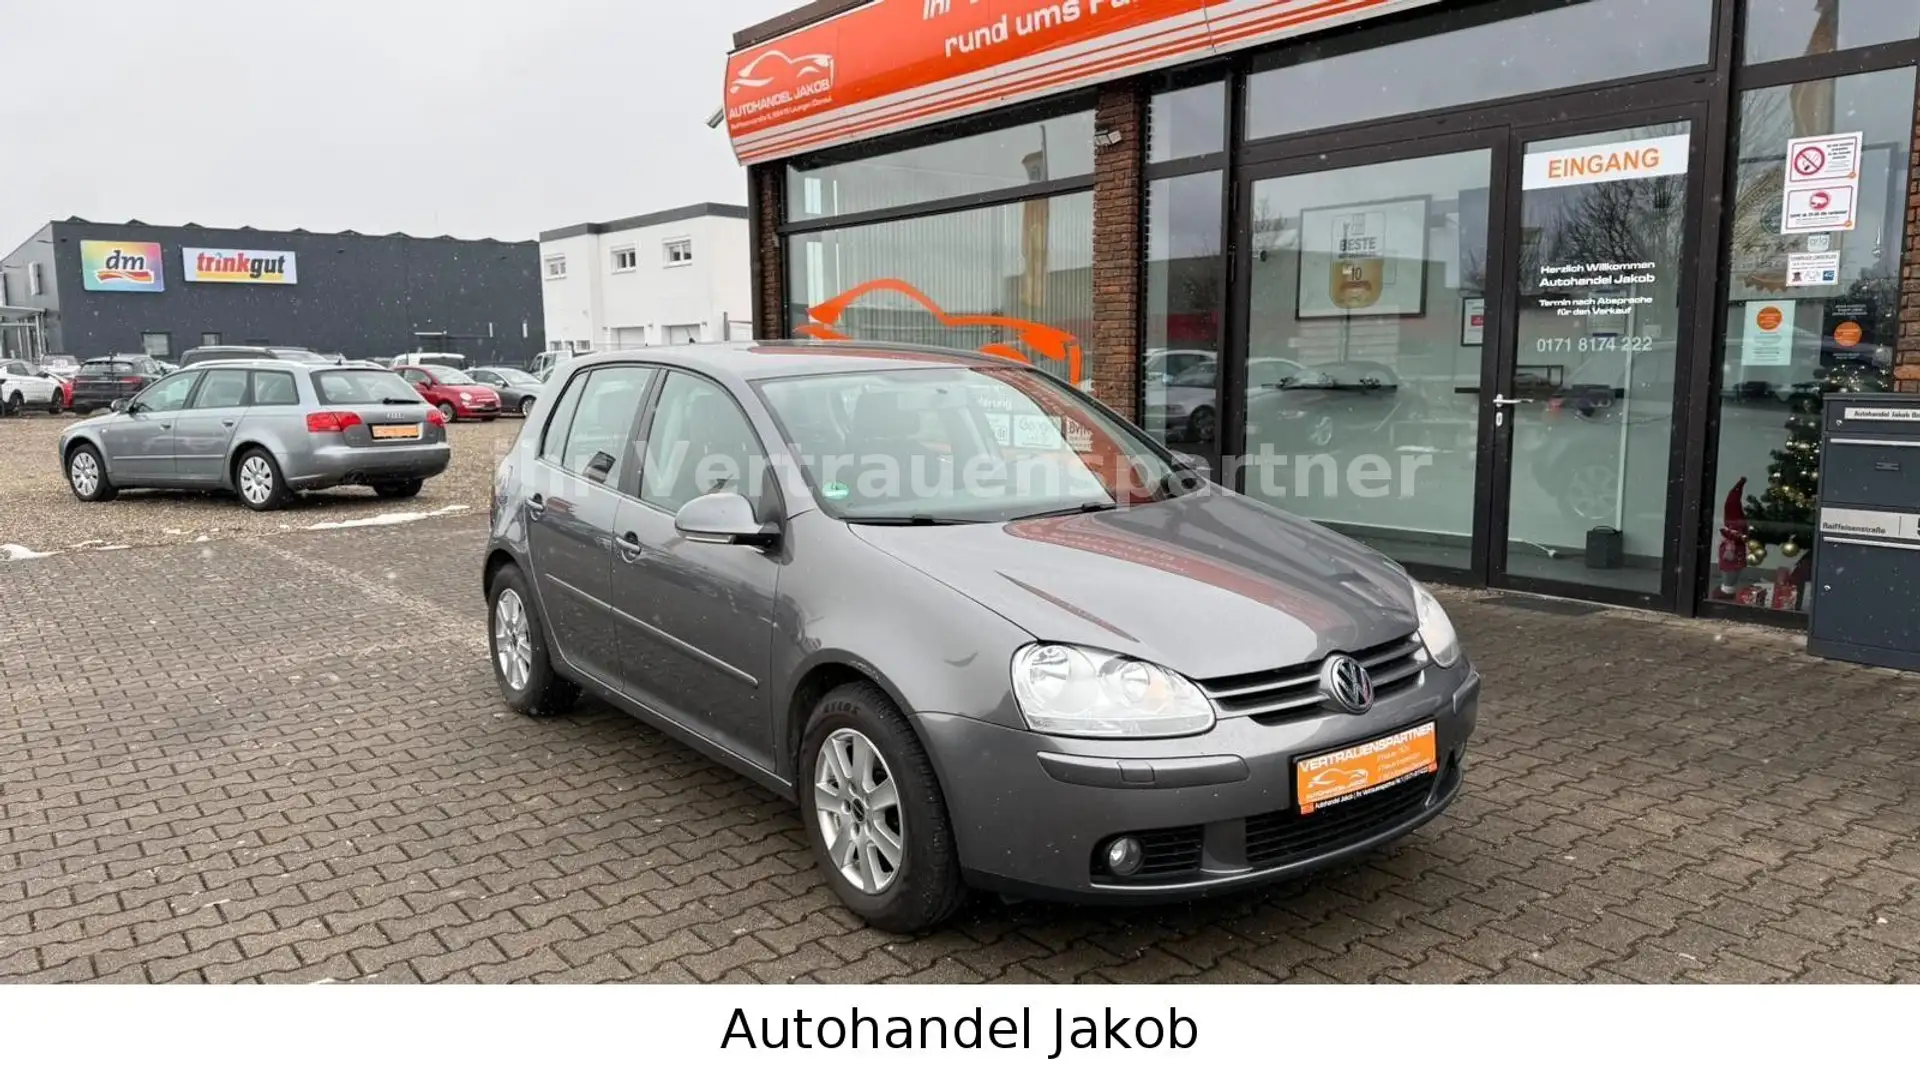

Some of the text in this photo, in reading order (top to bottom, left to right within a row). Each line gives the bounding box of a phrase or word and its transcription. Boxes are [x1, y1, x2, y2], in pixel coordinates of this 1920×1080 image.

[944, 0, 1081, 58] rund ums
[729, 90, 793, 120] AUTOHANDEL
[793, 78, 830, 101] JAKOB
[1548, 147, 1660, 179] EINGANG
[1339, 236, 1377, 252] BESTE
[106, 249, 144, 271] dm
[197, 252, 285, 279] trinkgut
[1540, 261, 1656, 274] Herzlich Willkommen
[1539, 273, 1656, 287] Autohandel Jakob
[1539, 296, 1653, 307] Termin nach Absprache
[1557, 307, 1632, 316] für den Verkauf
[1537, 336, 1653, 352] 0171 8174 222
[1822, 522, 1887, 534] Raiffeisenstraße
[1300, 721, 1434, 773] VERTRAUENSPARTNER
